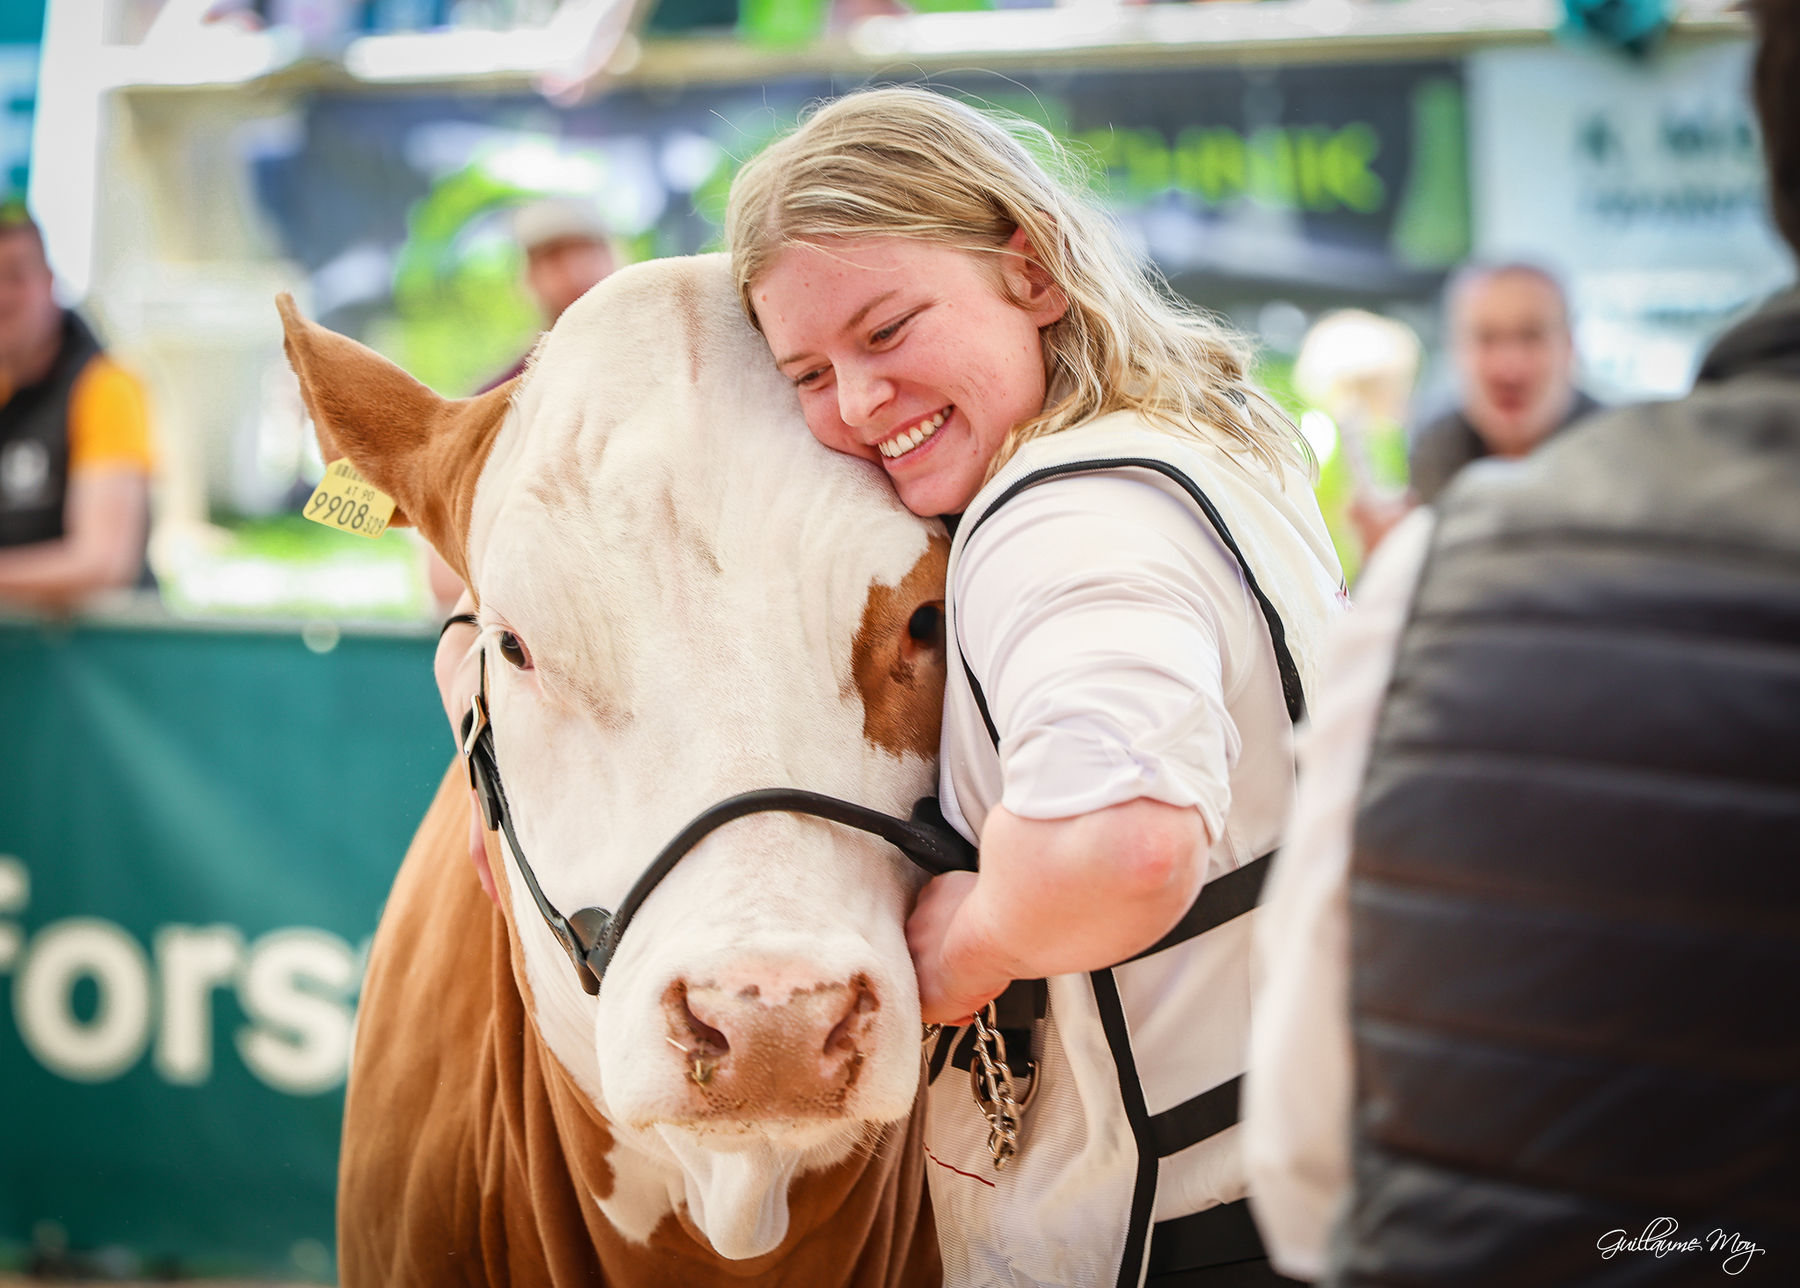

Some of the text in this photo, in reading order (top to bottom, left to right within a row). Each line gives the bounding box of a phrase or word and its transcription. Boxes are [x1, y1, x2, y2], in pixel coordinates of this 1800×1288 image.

[344, 485, 359, 496] AT
[308, 491, 370, 530] 9908
[0, 852, 372, 1096] ors
